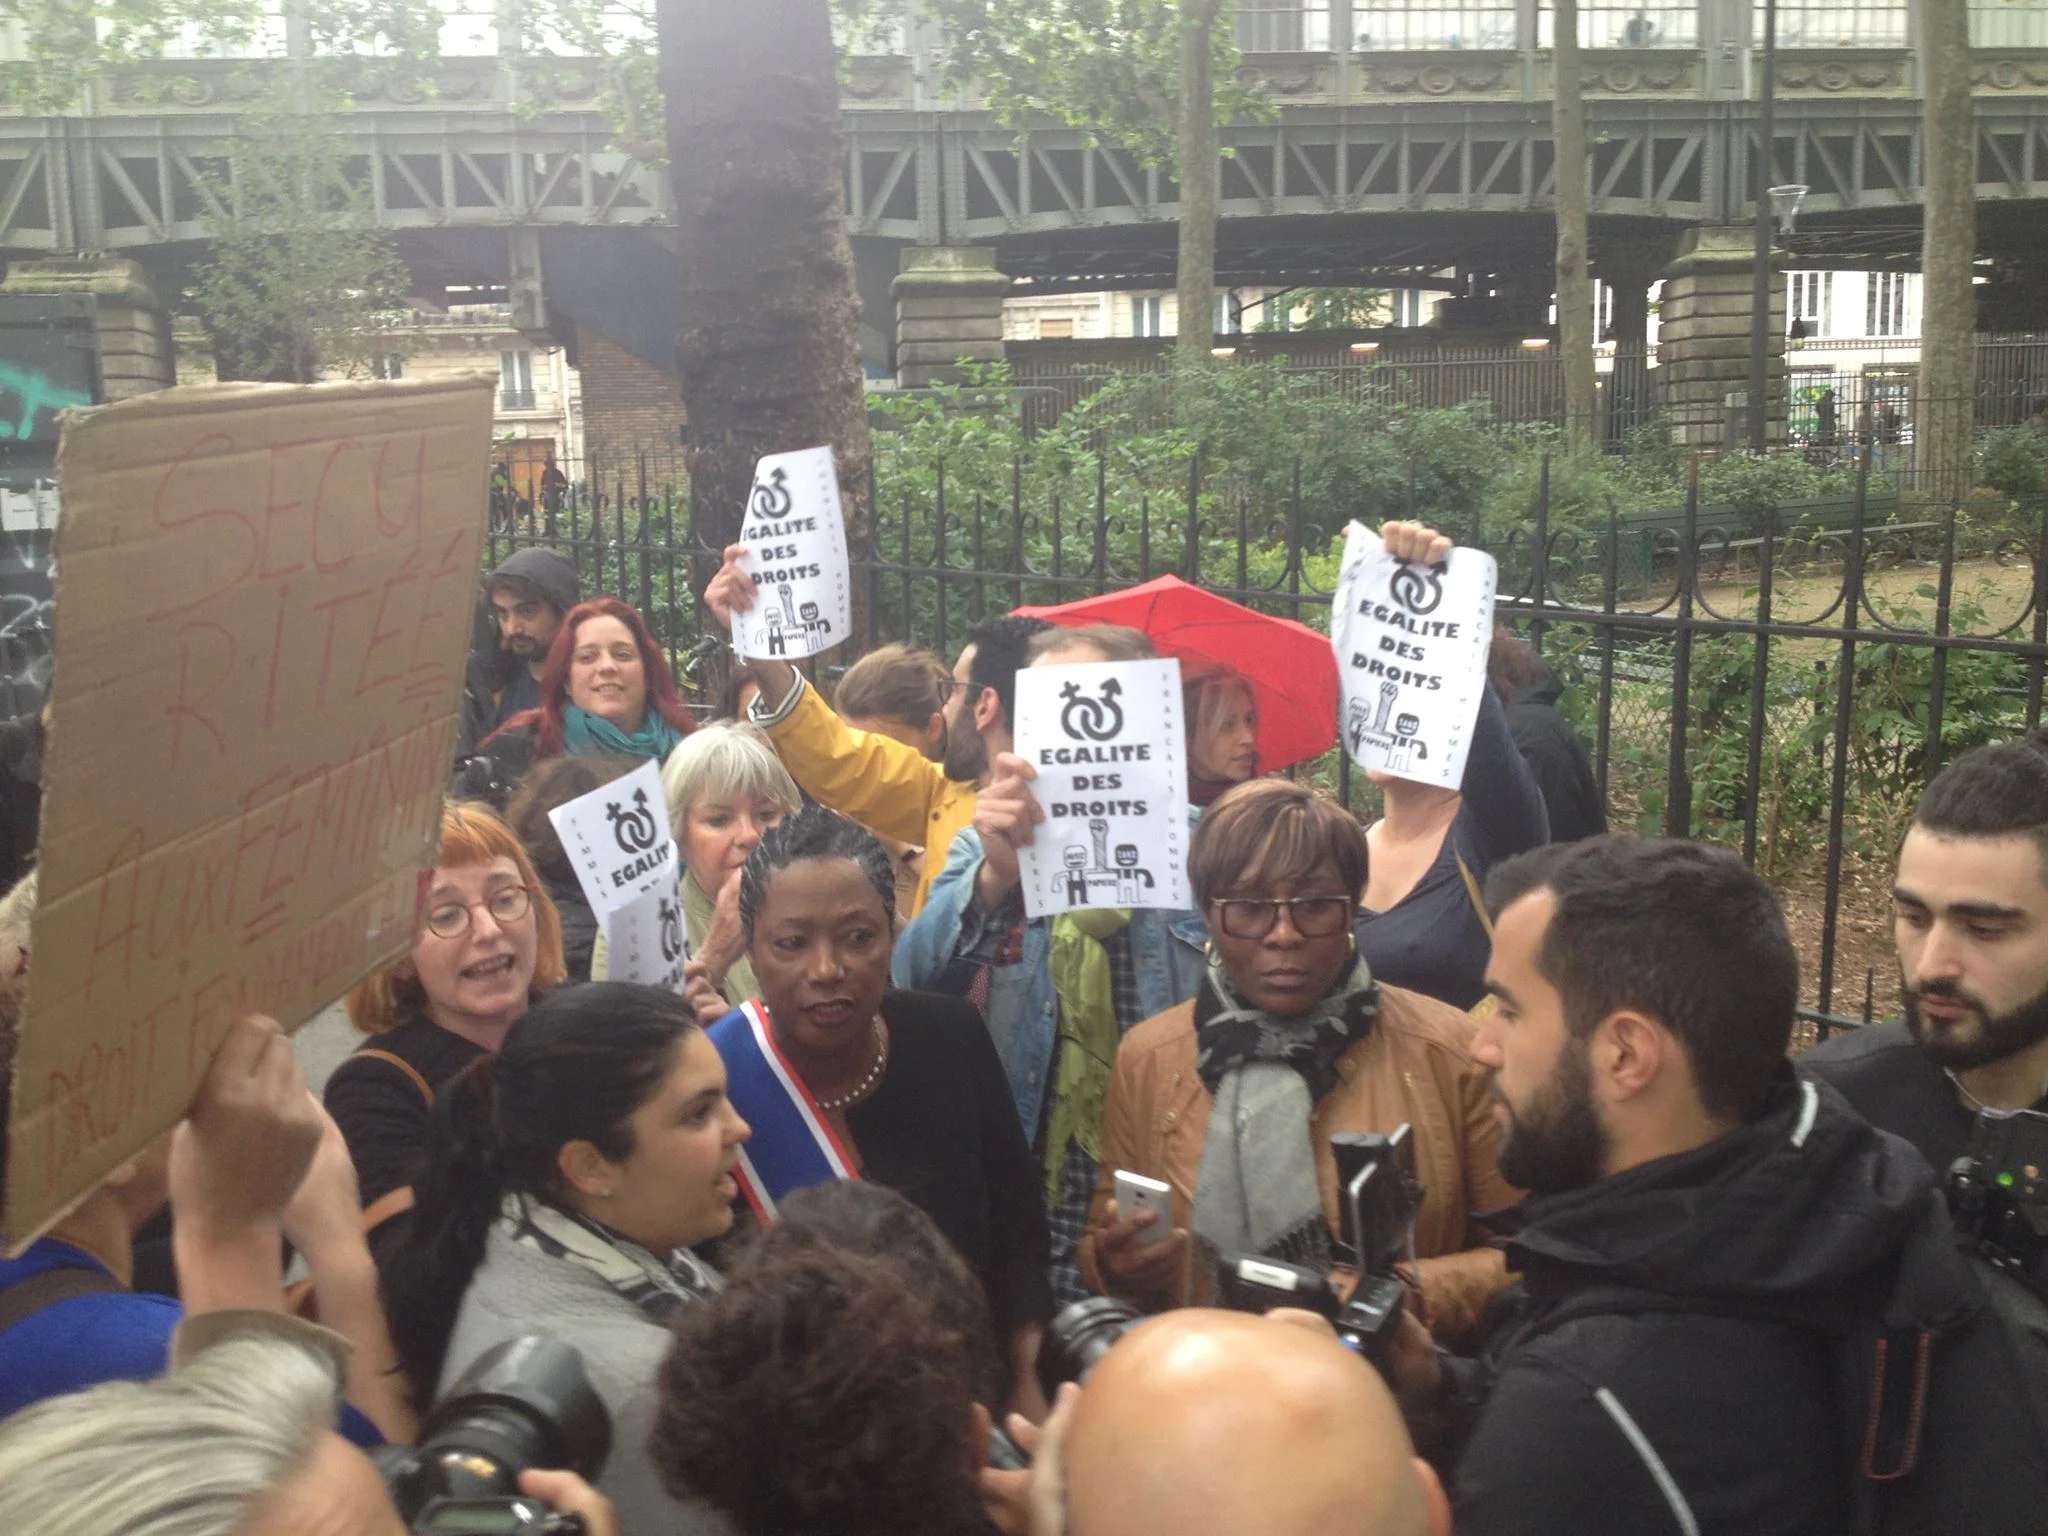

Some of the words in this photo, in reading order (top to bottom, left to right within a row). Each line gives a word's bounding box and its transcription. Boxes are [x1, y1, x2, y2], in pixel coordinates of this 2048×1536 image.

[761, 543, 798, 561] DES
[752, 562, 821, 585] DROITS
[1359, 598, 1461, 639] EGALITE
[1379, 634, 1426, 661] DES
[1351, 652, 1443, 690] DROITS
[1040, 744, 1151, 765] EGALITE
[1072, 773, 1122, 791] DES
[1051, 800, 1148, 818] DROITS
[611, 841, 669, 888] EGALIT
